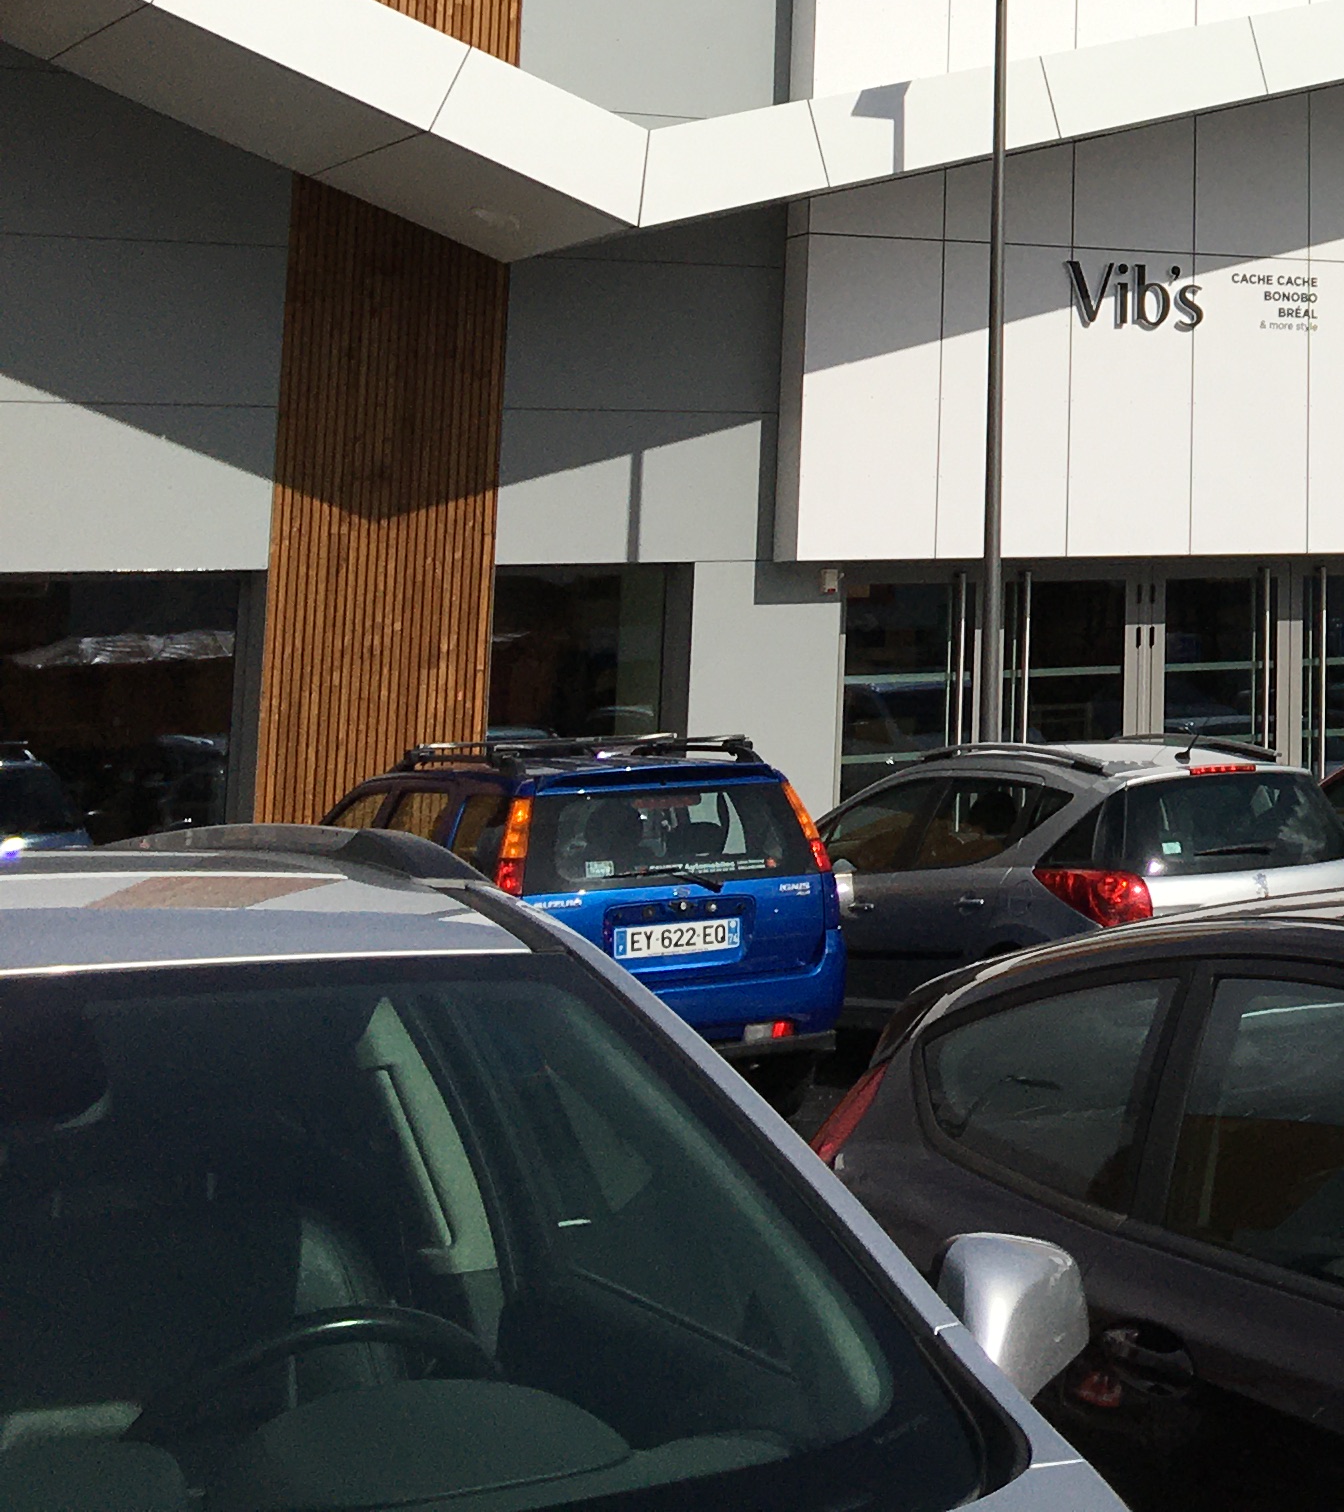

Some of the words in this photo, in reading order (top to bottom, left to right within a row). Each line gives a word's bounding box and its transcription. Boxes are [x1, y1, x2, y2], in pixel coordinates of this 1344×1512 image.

[1231, 272, 1274, 286] CACHE
[1277, 275, 1318, 288] CACHE
[1065, 260, 1204, 331] Vib's
[1263, 290, 1318, 304] BONOBO
[1278, 305, 1318, 320] BRÉAL
[1259, 319, 1267, 329] &
[1269, 322, 1294, 331] more
[1295, 322, 1318, 333] style
